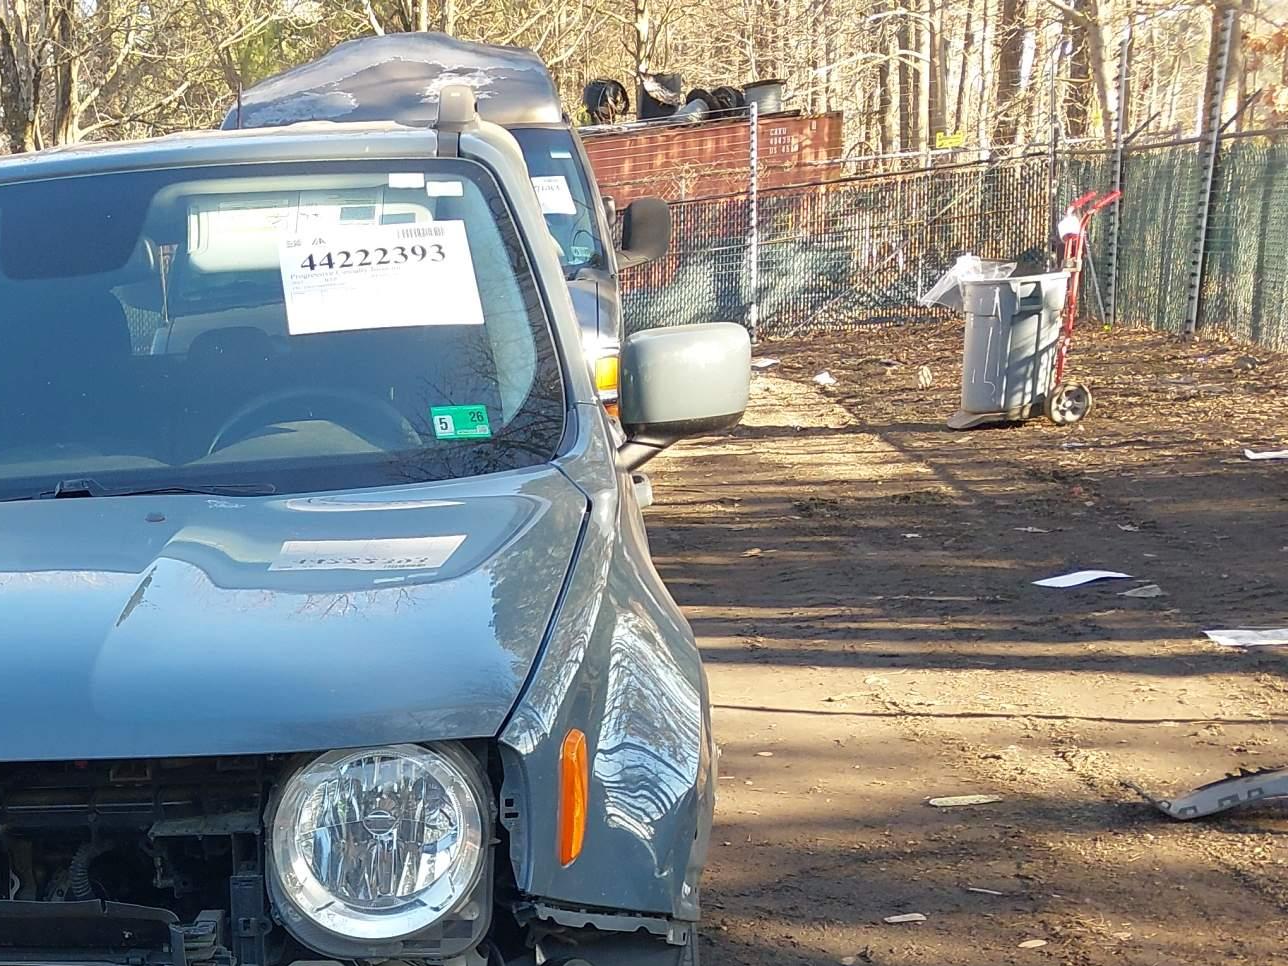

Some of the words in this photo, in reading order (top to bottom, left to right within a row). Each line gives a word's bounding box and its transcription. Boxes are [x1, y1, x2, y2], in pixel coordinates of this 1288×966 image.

[300, 244, 446, 271] 44222393
[468, 411, 484, 422] 26
[439, 417, 449, 431] 5
